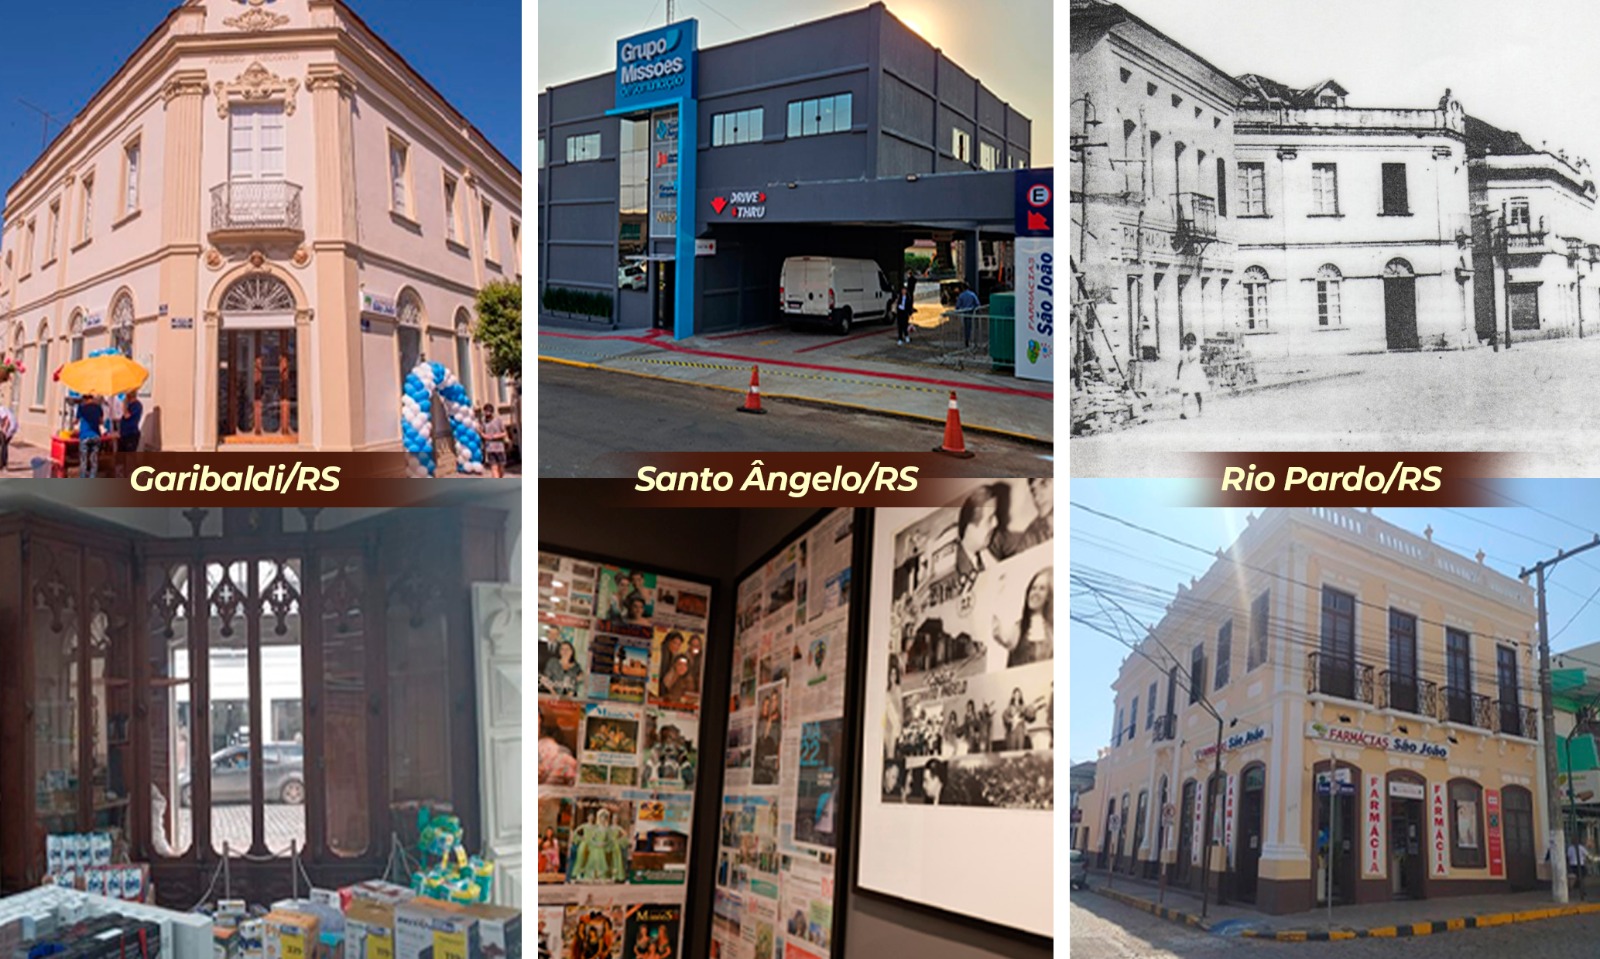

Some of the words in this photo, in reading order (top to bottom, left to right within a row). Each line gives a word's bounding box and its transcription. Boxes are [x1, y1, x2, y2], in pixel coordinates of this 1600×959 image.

[621, 38, 667, 62] Grupo
[730, 191, 759, 204] DRIVE
[737, 206, 765, 218] THRU
[1036, 252, 1053, 297] João
[1036, 300, 1053, 336] São
[800, 738, 820, 766] 22
[1393, 738, 1417, 753] São
[1419, 743, 1447, 758] João
